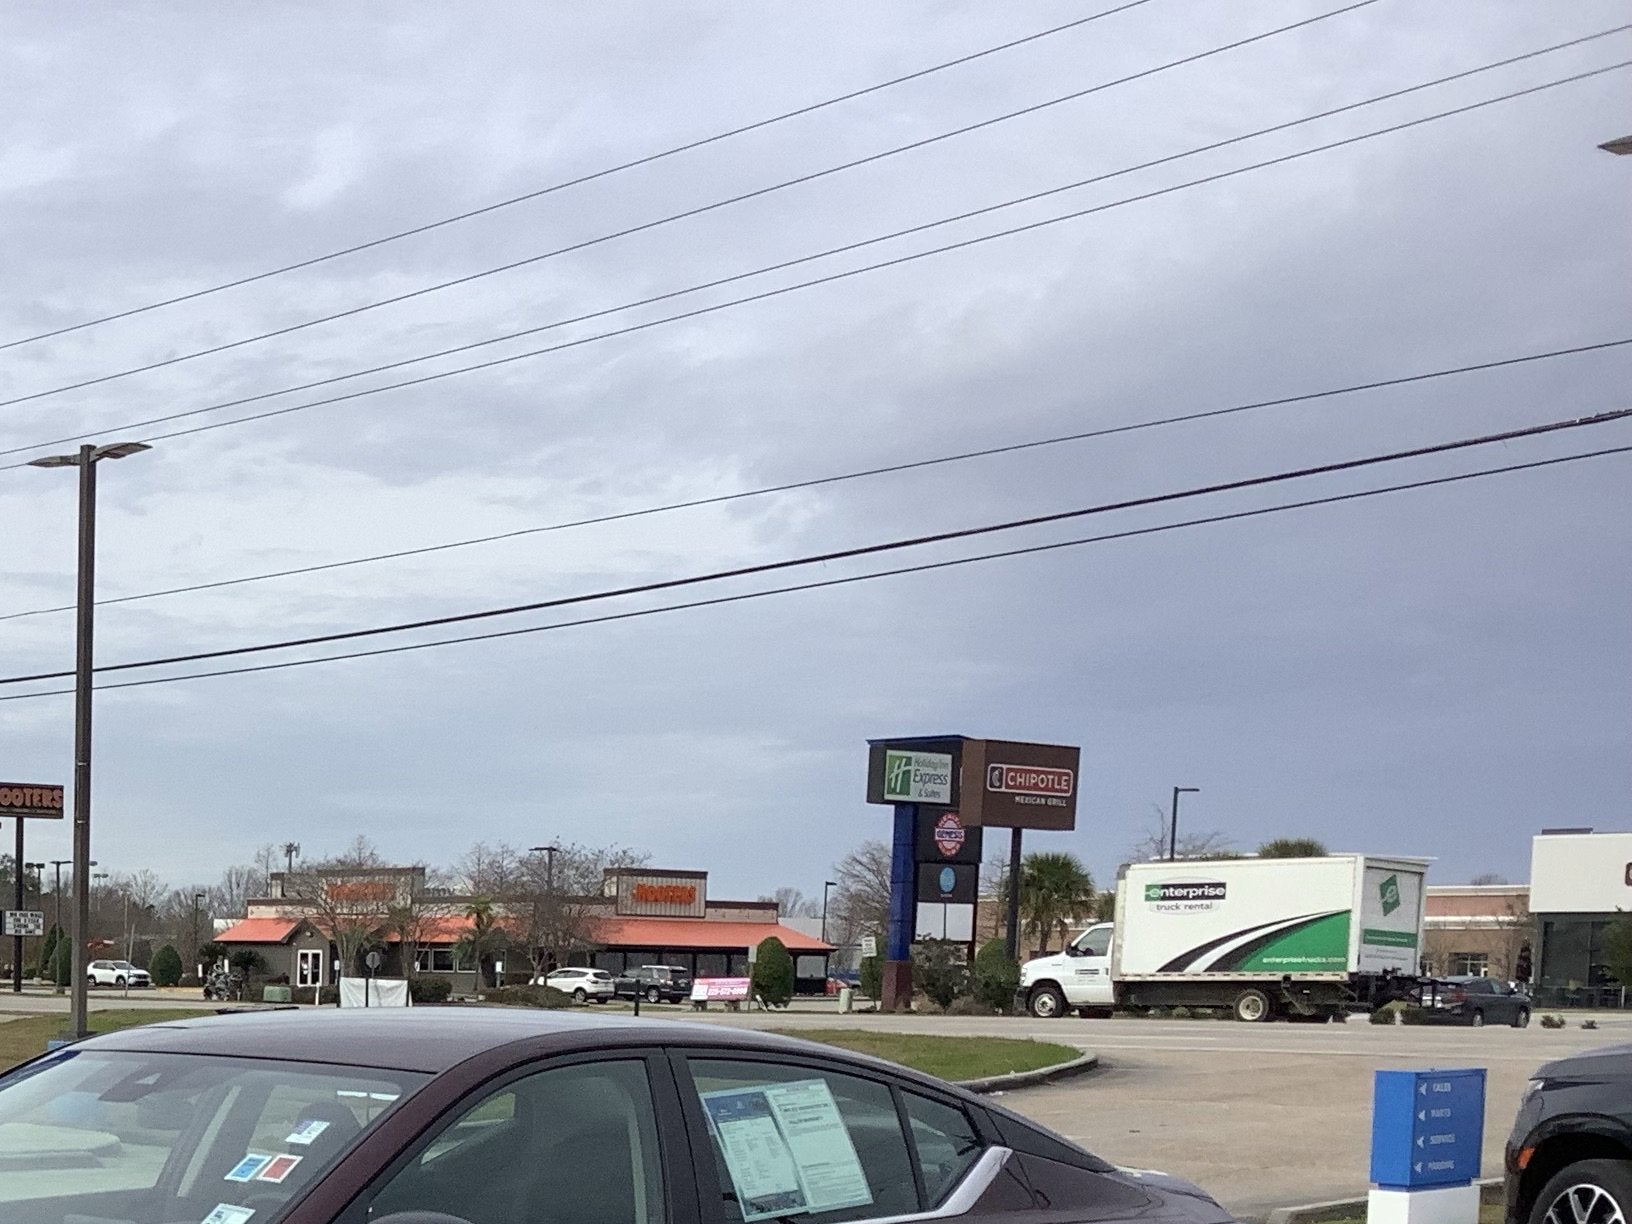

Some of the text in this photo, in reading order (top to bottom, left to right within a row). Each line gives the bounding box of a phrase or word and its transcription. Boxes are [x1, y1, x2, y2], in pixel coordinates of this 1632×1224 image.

[913, 768, 948, 787] Express
[1007, 771, 1069, 790] CHIPOTLE
[1015, 795, 1067, 808] MEXICAN GRILL
[1146, 884, 1226, 900] enterprise
[1156, 901, 1213, 911] truck rental
